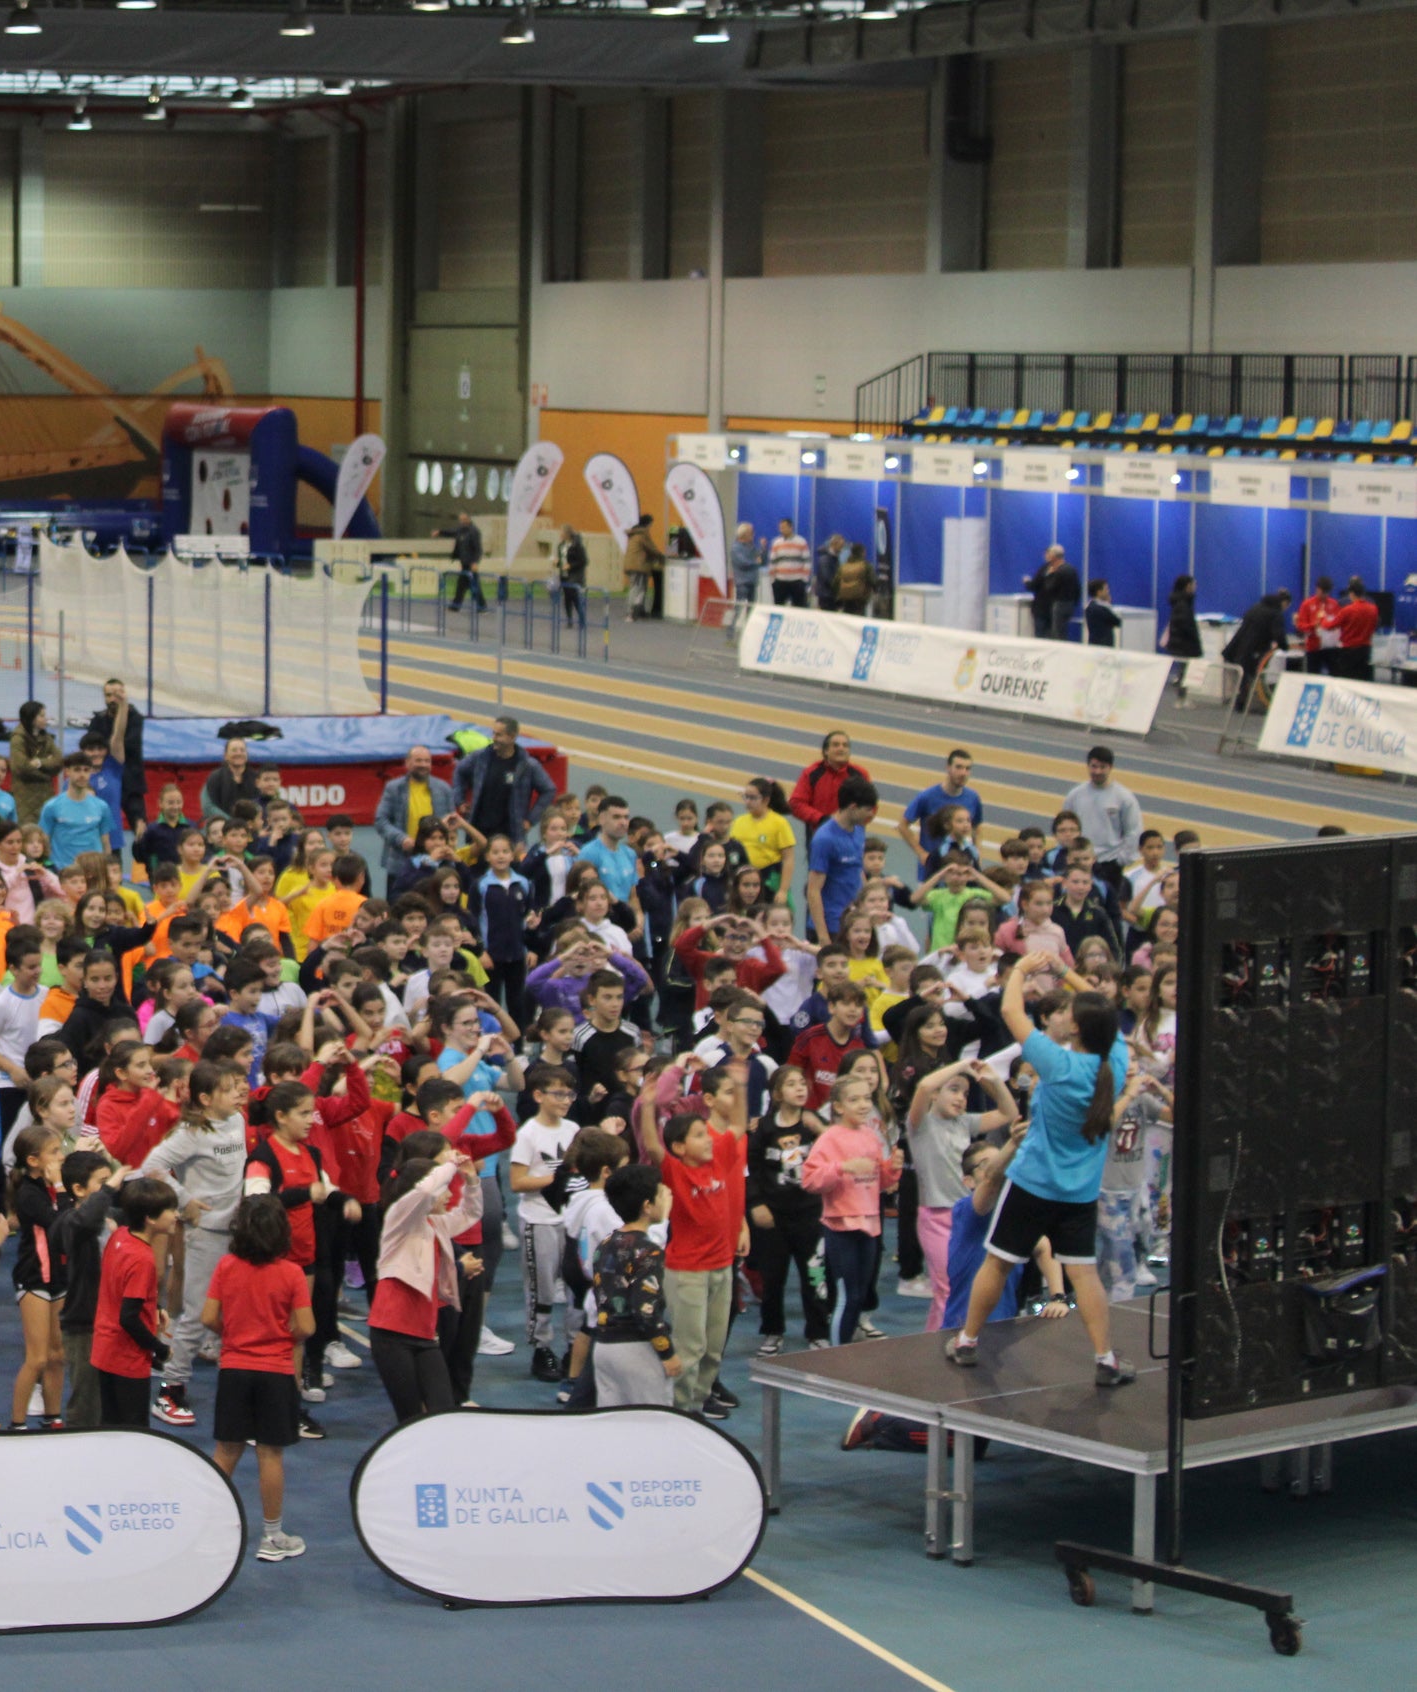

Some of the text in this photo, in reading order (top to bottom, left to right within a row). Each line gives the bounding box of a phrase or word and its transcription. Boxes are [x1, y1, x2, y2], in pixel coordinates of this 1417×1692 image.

[783, 618, 820, 640] XUNTA
[775, 643, 835, 667] DE GALICIA
[987, 651, 1045, 673] Concello de
[980, 674, 1049, 700] OURENSE
[1327, 690, 1382, 721] XUNTA
[1316, 721, 1407, 758] DE GALICIA
[455, 1487, 524, 1503] XUNTA
[630, 1479, 702, 1493] DEPORTE
[108, 1502, 181, 1516] DEPORTE
[631, 1494, 697, 1508] GALEGO
[109, 1518, 175, 1531] GALEGO
[456, 1507, 570, 1525] DE GALICIA
